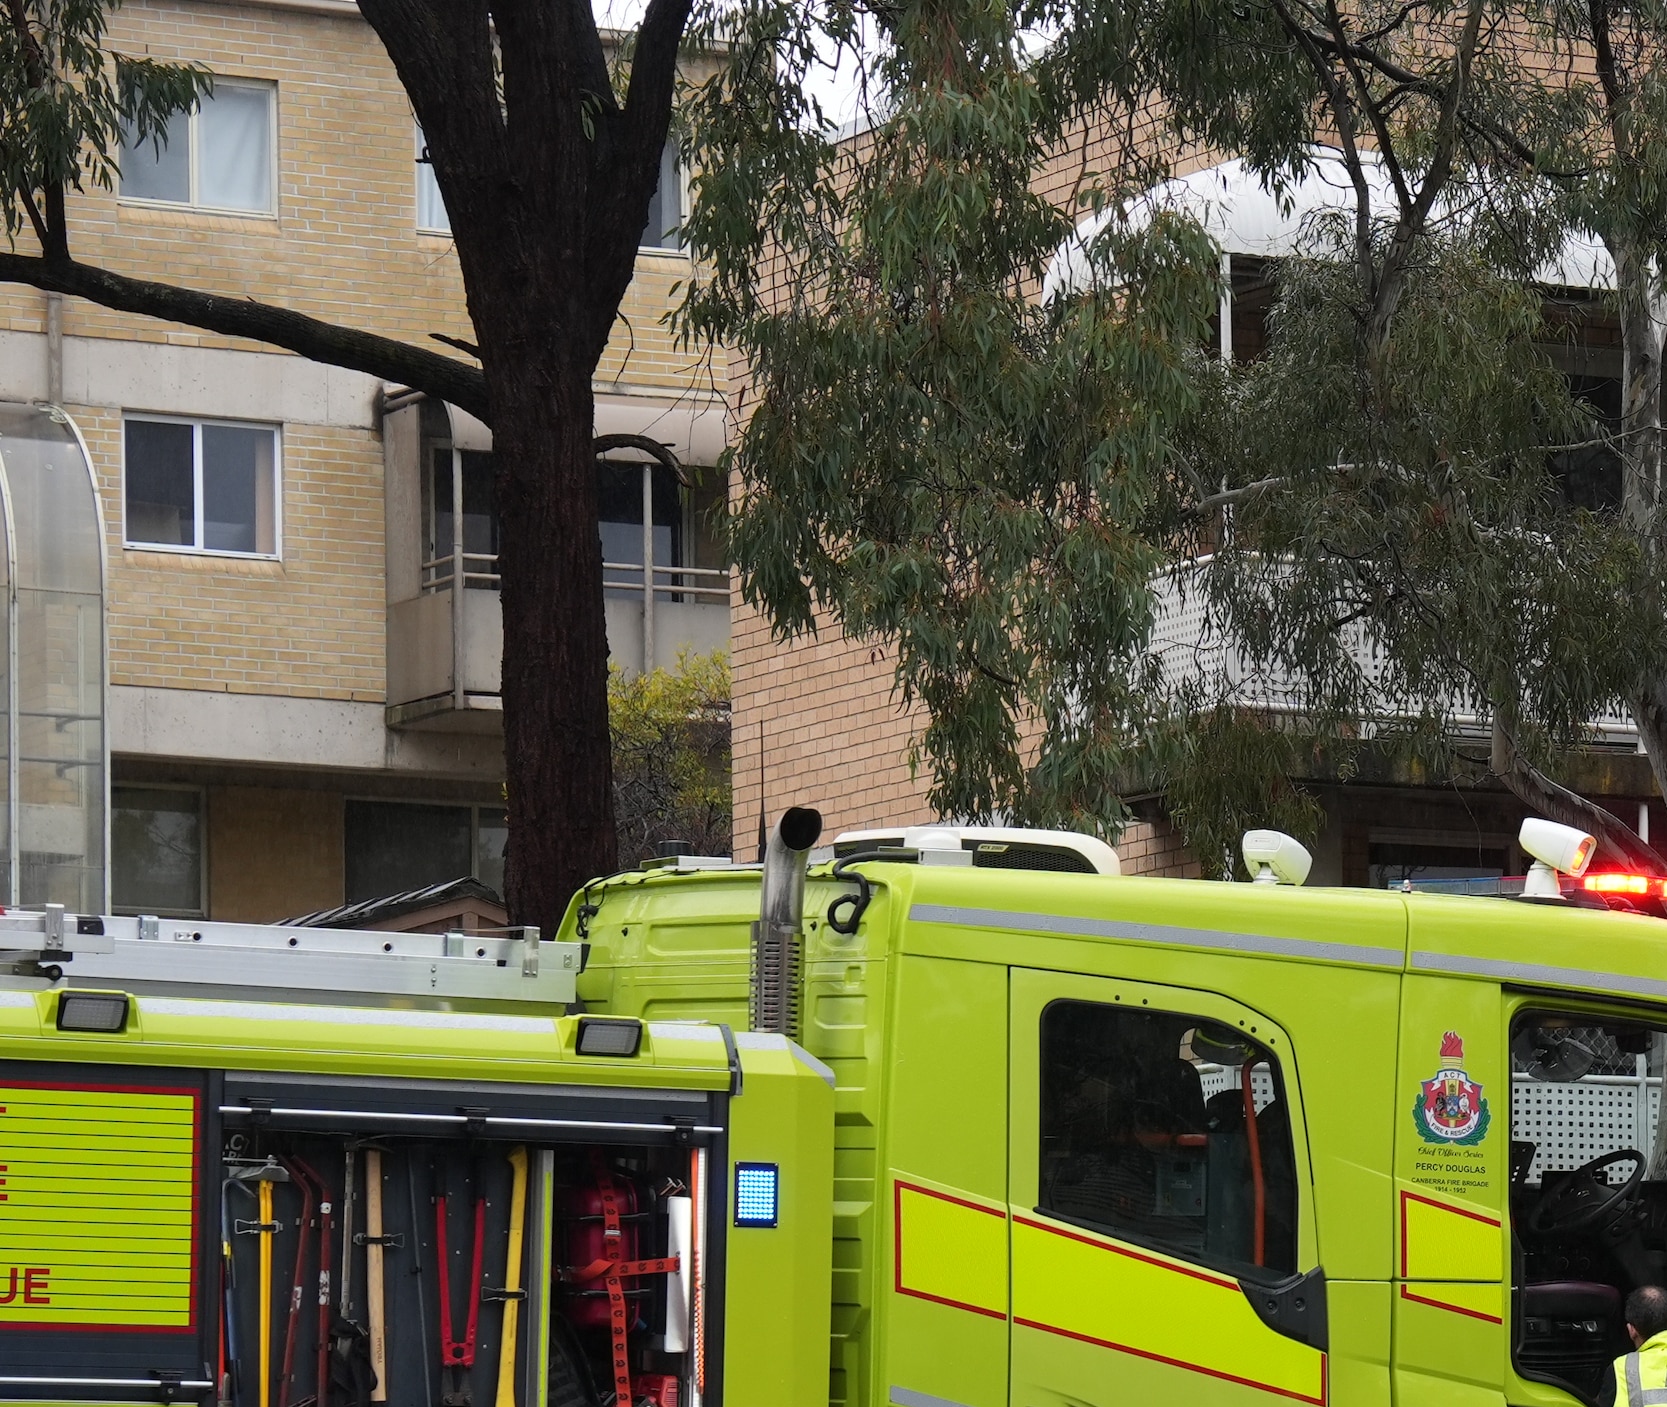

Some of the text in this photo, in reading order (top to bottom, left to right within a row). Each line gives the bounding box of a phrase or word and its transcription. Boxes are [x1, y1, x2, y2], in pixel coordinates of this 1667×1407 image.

[1443, 1071, 1460, 1080] ACT
[1430, 1122, 1445, 1135] FIRE
[1450, 1124, 1473, 1137] RESCUE
[1415, 1162, 1486, 1174] PERCY DOUGLAS
[1411, 1177, 1446, 1185] CANBERRA
